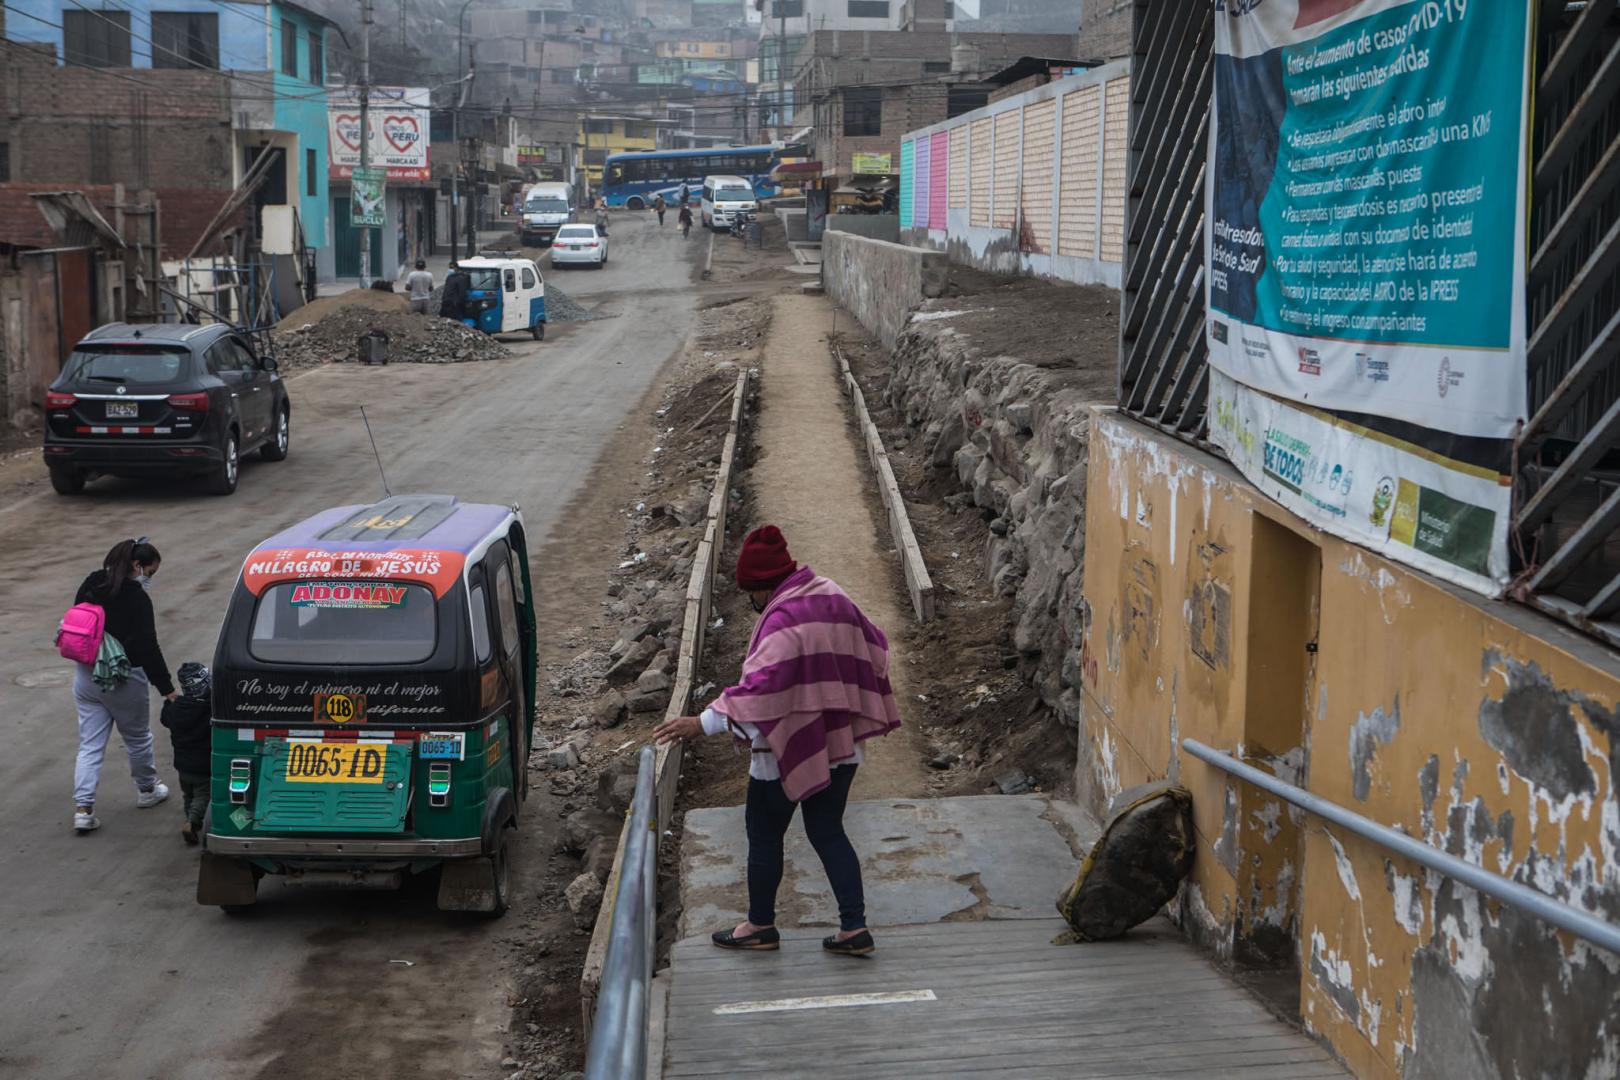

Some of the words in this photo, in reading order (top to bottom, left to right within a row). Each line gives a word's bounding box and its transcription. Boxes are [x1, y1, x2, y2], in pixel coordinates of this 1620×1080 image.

[1287, 55, 1304, 76] Ante
[1305, 46, 1317, 70] el
[1314, 39, 1355, 67] aumento
[1357, 29, 1371, 54] de
[1374, 24, 1407, 50] casos
[1321, 76, 1334, 98] las
[1336, 65, 1388, 100] siguientes
[1388, 104, 1397, 126] el
[346, 131, 375, 140] PEU
[1357, 145, 1374, 161] con
[1441, 124, 1469, 142] una
[1358, 196, 1385, 217] dosis
[1387, 200, 1398, 215] es
[1344, 231, 1359, 245] con
[1361, 231, 1373, 245] su
[1412, 218, 1429, 240] de
[1362, 253, 1370, 273] la
[1408, 248, 1436, 270] hará
[1439, 247, 1451, 269] de
[1305, 287, 1312, 305] y
[1312, 280, 1319, 300] la
[1399, 280, 1415, 301] de
[1417, 279, 1428, 301] la
[1313, 307, 1321, 326] el
[1322, 308, 1351, 332] ingreso
[249, 561, 331, 575] MILAGRO
[342, 560, 361, 573] DE
[376, 561, 441, 575] JESUS
[291, 585, 407, 604] ADONAY
[237, 679, 262, 696] No
[266, 683, 290, 700] soy
[293, 681, 309, 694] el
[309, 683, 361, 696] primero
[365, 683, 381, 695] ni
[384, 682, 399, 695] el
[401, 684, 441, 701] mejor
[236, 702, 314, 714] simplemente
[367, 704, 446, 716] diferente
[330, 698, 352, 717] 118
[289, 744, 381, 778] 0065-1D
